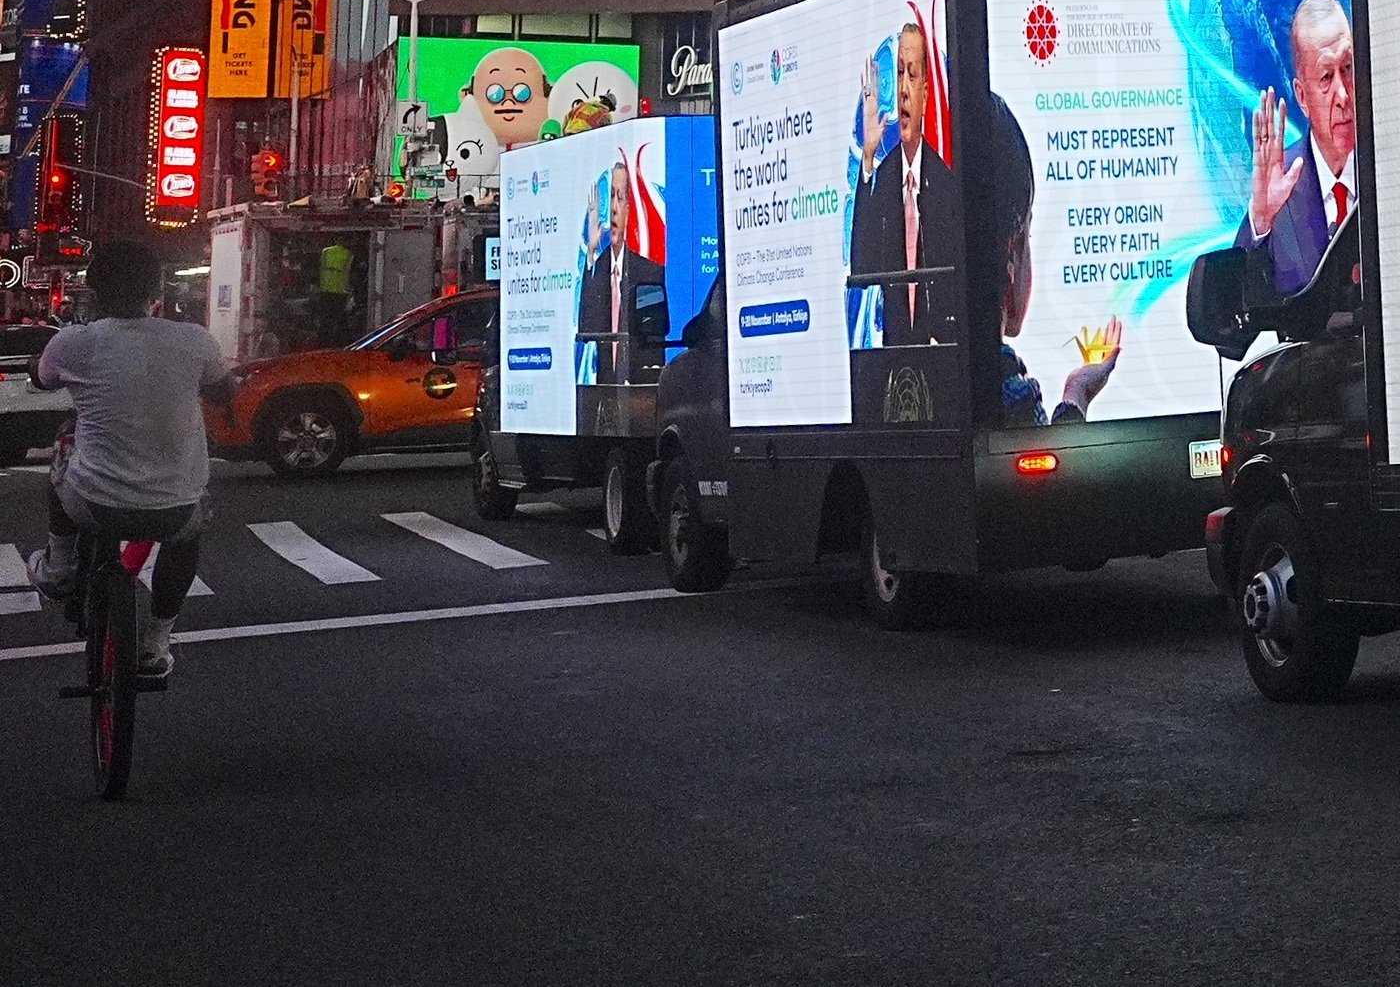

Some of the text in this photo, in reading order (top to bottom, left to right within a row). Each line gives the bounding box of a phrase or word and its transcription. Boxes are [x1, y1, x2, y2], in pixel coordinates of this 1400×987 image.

[1067, 21, 1154, 38] DIRECTORATE OF
[1067, 38, 1161, 55] COMMUNICATIONS
[1035, 88, 1183, 111] GLOBAL GOVERNANCE
[732, 106, 813, 155] Türkiye where
[1047, 127, 1175, 151] MUST REPRESENT
[734, 148, 787, 191] the world
[1046, 156, 1178, 181] ALL OF HUMANITY
[735, 184, 838, 231] unites for climate
[1068, 204, 1163, 226] EVERY ORIGIN
[534, 212, 558, 235] where
[507, 245, 519, 267] the
[520, 241, 541, 265] world
[1074, 232, 1160, 255] EVERY FAITH
[507, 268, 573, 295] unites for climate
[1063, 259, 1173, 284] EVERY CULTURE
